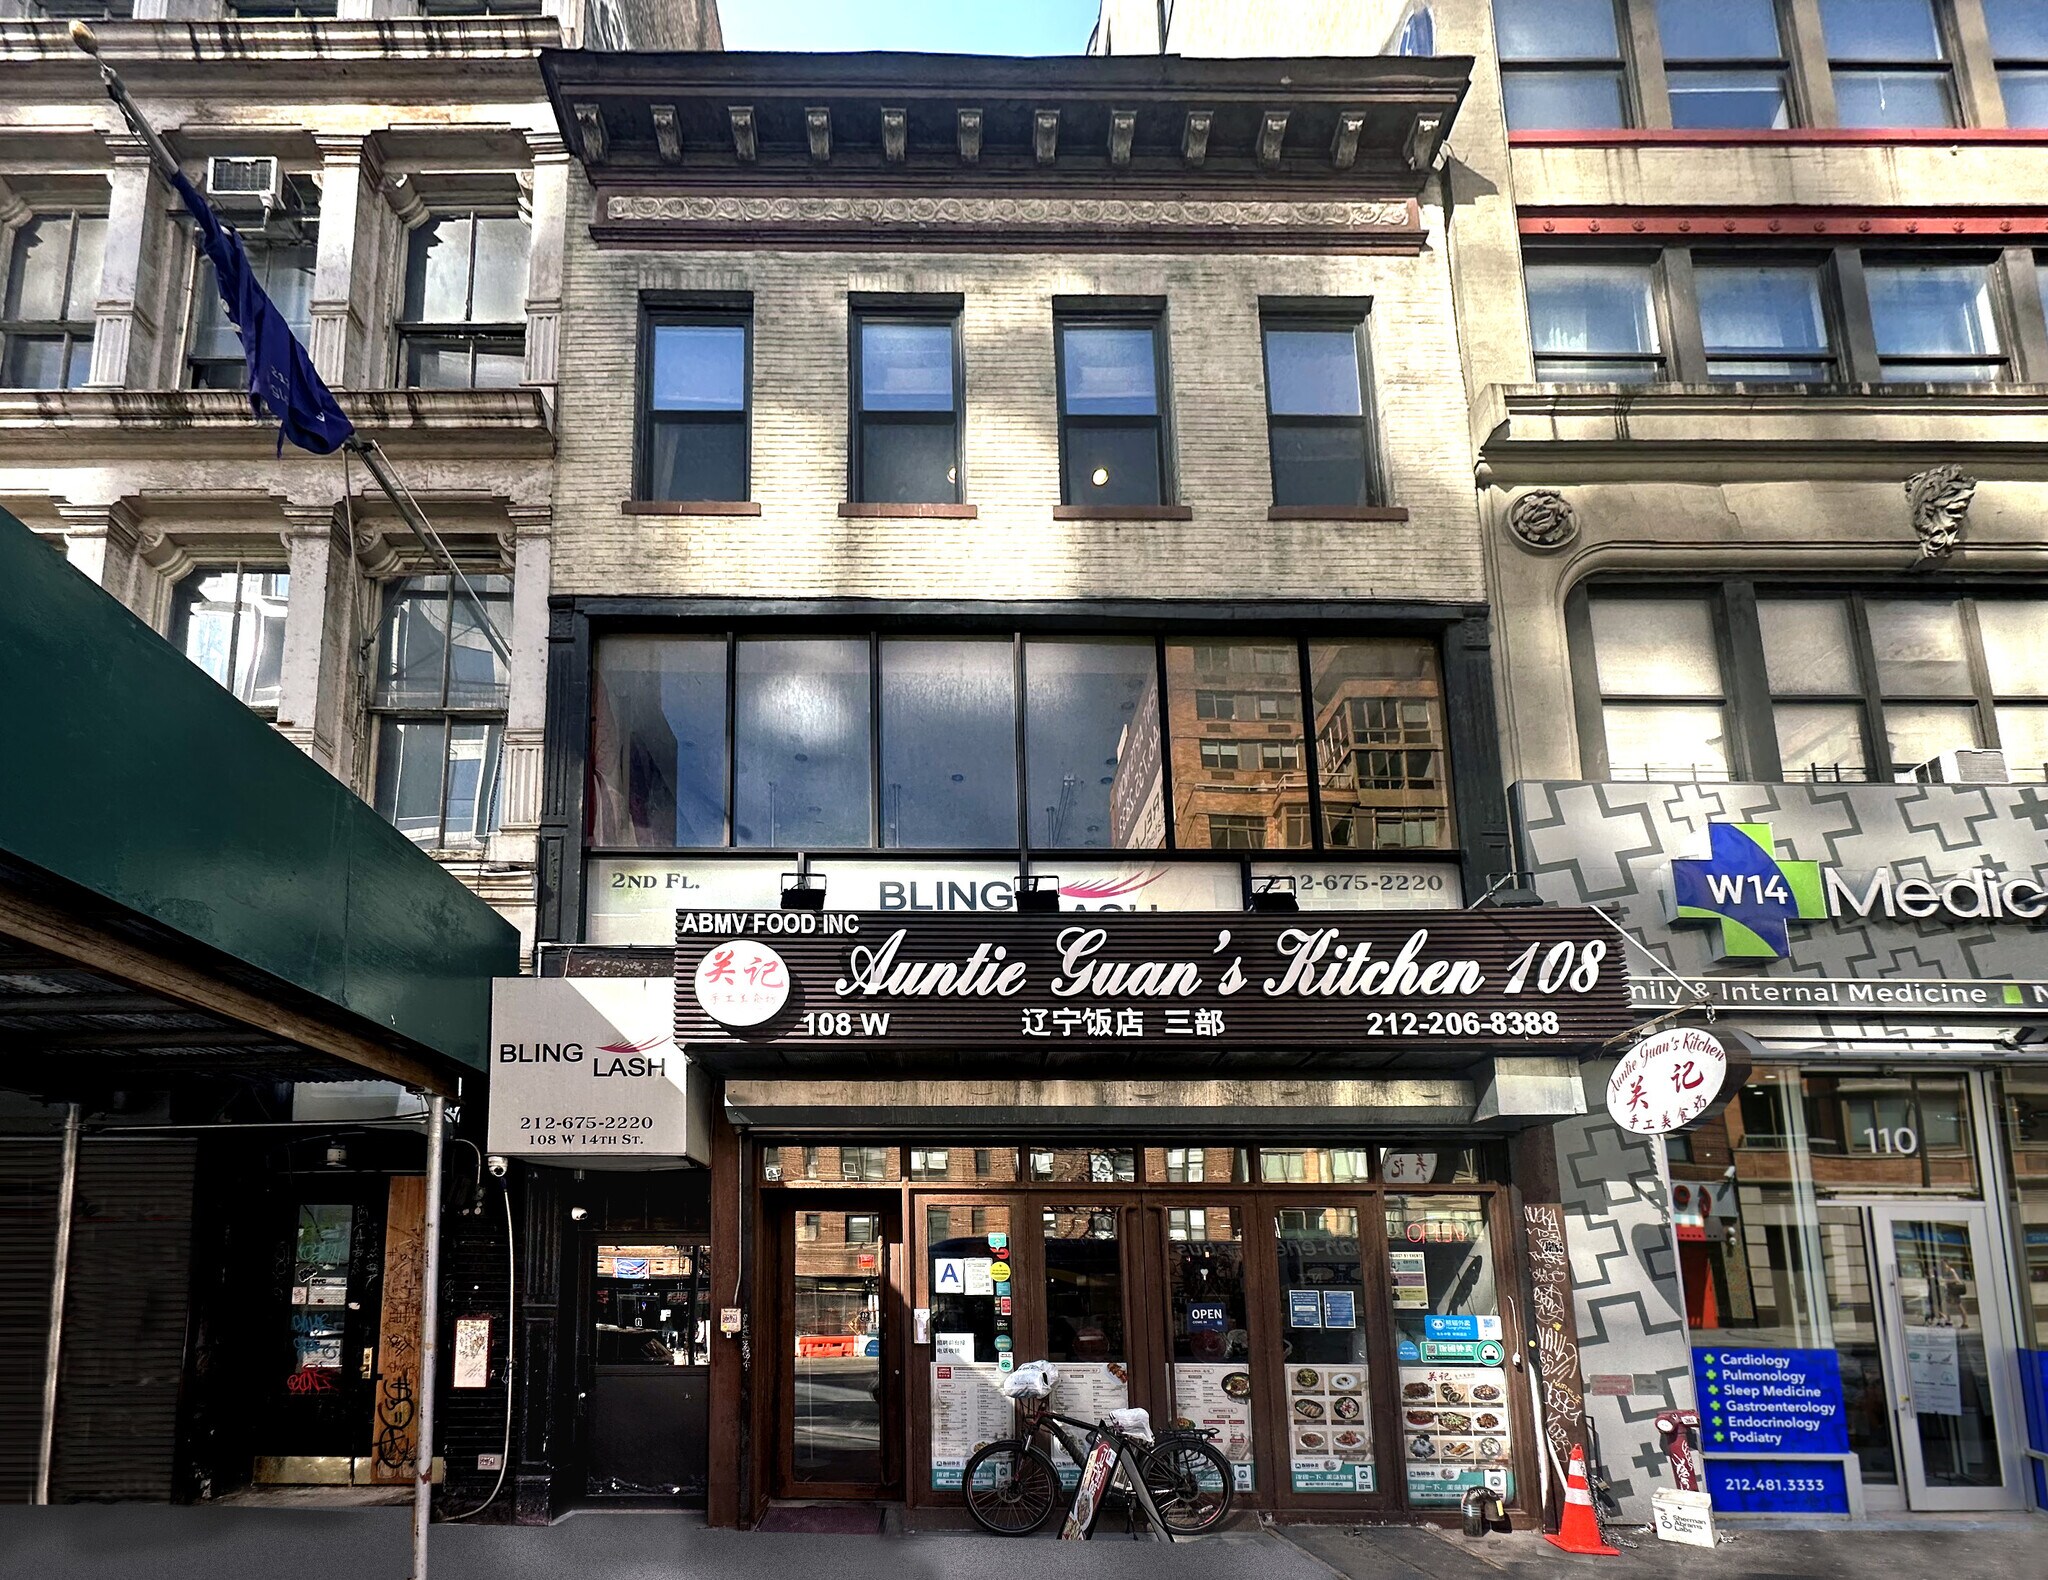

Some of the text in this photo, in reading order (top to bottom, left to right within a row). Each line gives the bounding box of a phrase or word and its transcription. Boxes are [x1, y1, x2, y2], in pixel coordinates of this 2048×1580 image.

[611, 872, 701, 890] 2ND FL.
[1268, 874, 1443, 891] 2-675-2220
[1707, 874, 1788, 905] W14
[879, 881, 1014, 911] BLING
[1825, 866, 2048, 919] Medic
[682, 913, 860, 935] ABMV FOOD INC
[704, 949, 785, 989] 关记
[834, 926, 1609, 998] Auntie Guan's Kitchen 108
[1694, 982, 1710, 1000] &
[1721, 982, 1838, 1003] Internal
[1853, 983, 1987, 1004] Medicine
[803, 1012, 891, 1037] 108 W
[1021, 1007, 1226, 1038] 辽宁饭店 三部
[1366, 1010, 1560, 1037] 212-206-8388
[500, 1043, 666, 1078] BLING LASH
[1610, 1032, 1726, 1104] Auntie Guan's Kitchen
[1626, 1060, 1705, 1113] 关记
[520, 1116, 653, 1130] 212-675-2220
[529, 1134, 557, 1146] 108
[562, 1135, 576, 1146] W
[1863, 1126, 1917, 1156] 110
[1406, 1223, 1465, 1244] OPEN
[940, 1263, 959, 1283] A
[1191, 1308, 1223, 1320] OPEN
[1720, 1353, 1791, 1369] Cardiology
[1722, 1369, 1806, 1385] Pulmonology
[1724, 1384, 1822, 1400] Sleep Medicine
[1726, 1400, 1836, 1417] Gastroenterology
[1728, 1415, 1821, 1432] Endocrinology
[1730, 1431, 1782, 1446] Podiatry
[1725, 1478, 1825, 1493] 212.481.3333
[1673, 1514, 1707, 1526] Sherman
[1674, 1520, 1704, 1531] Abrams
[1674, 1525, 1693, 1534] Labs
